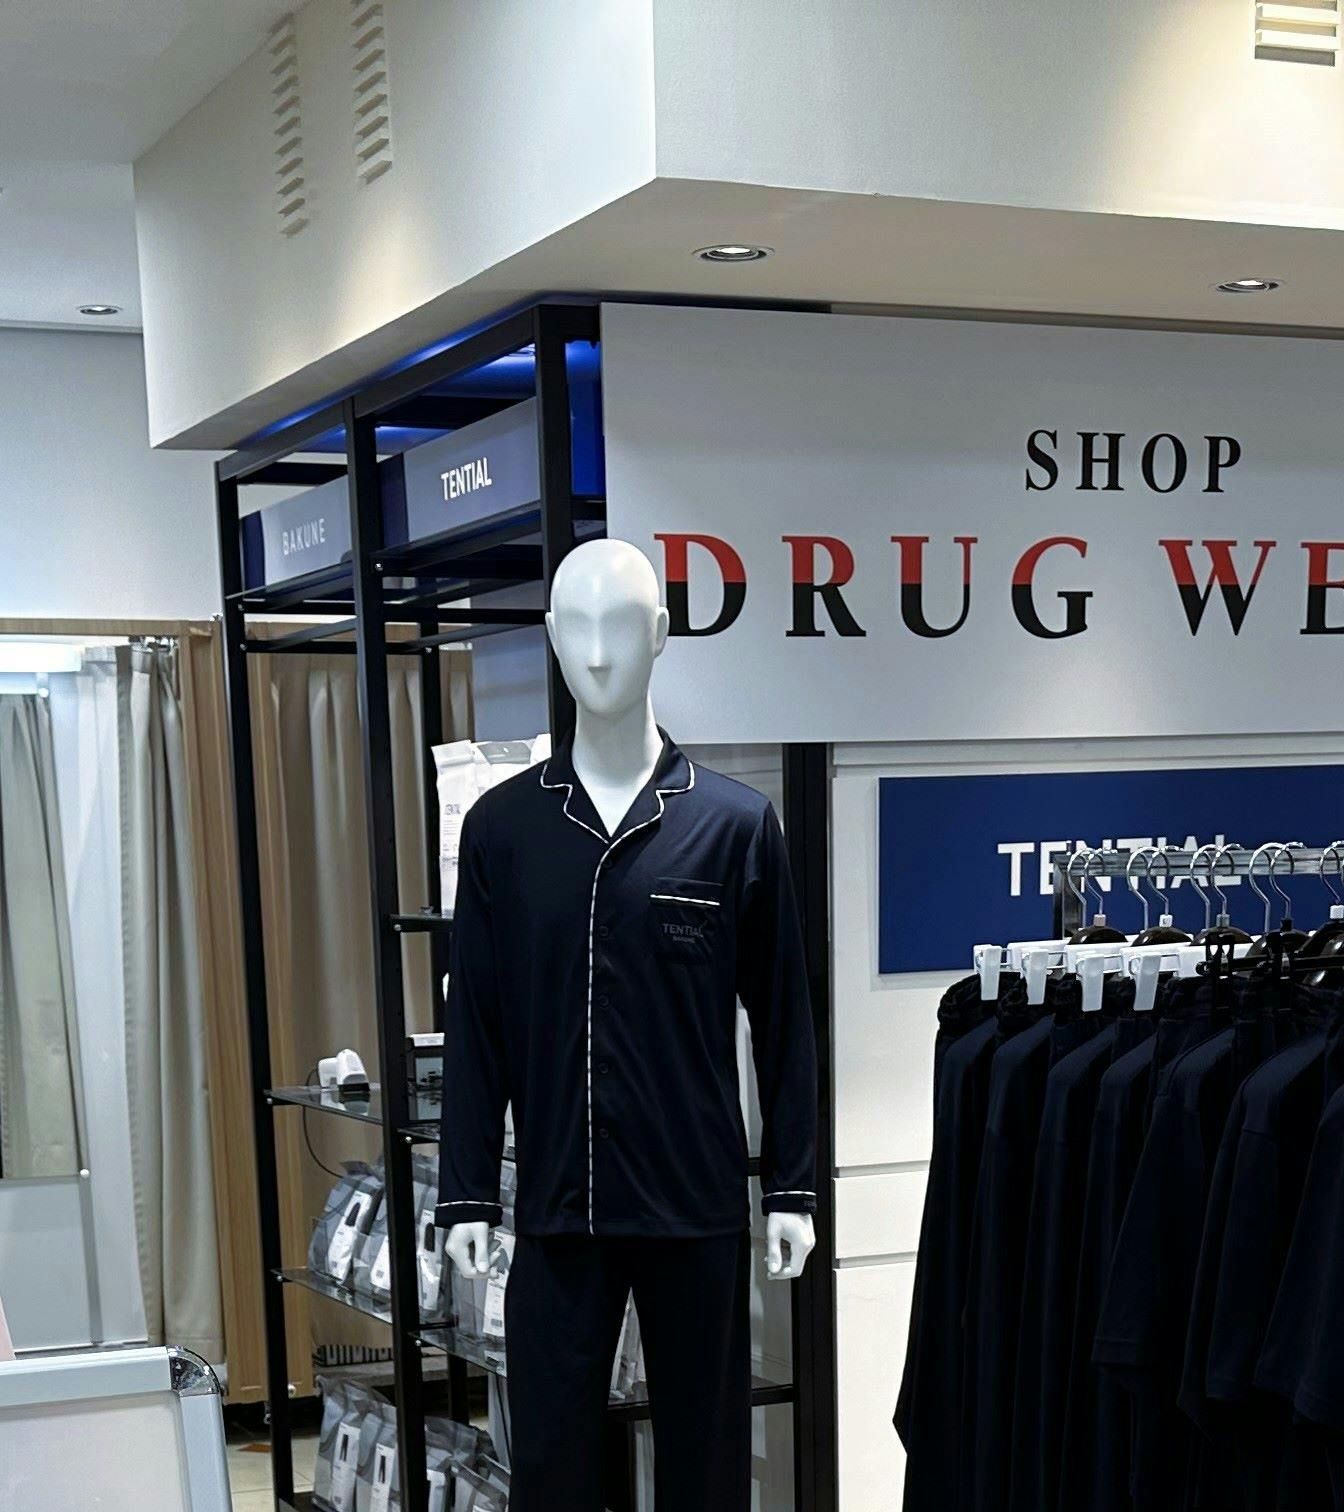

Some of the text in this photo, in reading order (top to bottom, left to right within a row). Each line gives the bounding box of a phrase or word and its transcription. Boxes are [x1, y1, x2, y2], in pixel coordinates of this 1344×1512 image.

[440, 456, 492, 500] TENTIAL
[1025, 429, 1242, 493] SHOP
[282, 518, 326, 555] BAKUNE
[653, 532, 1094, 639] DRUG
